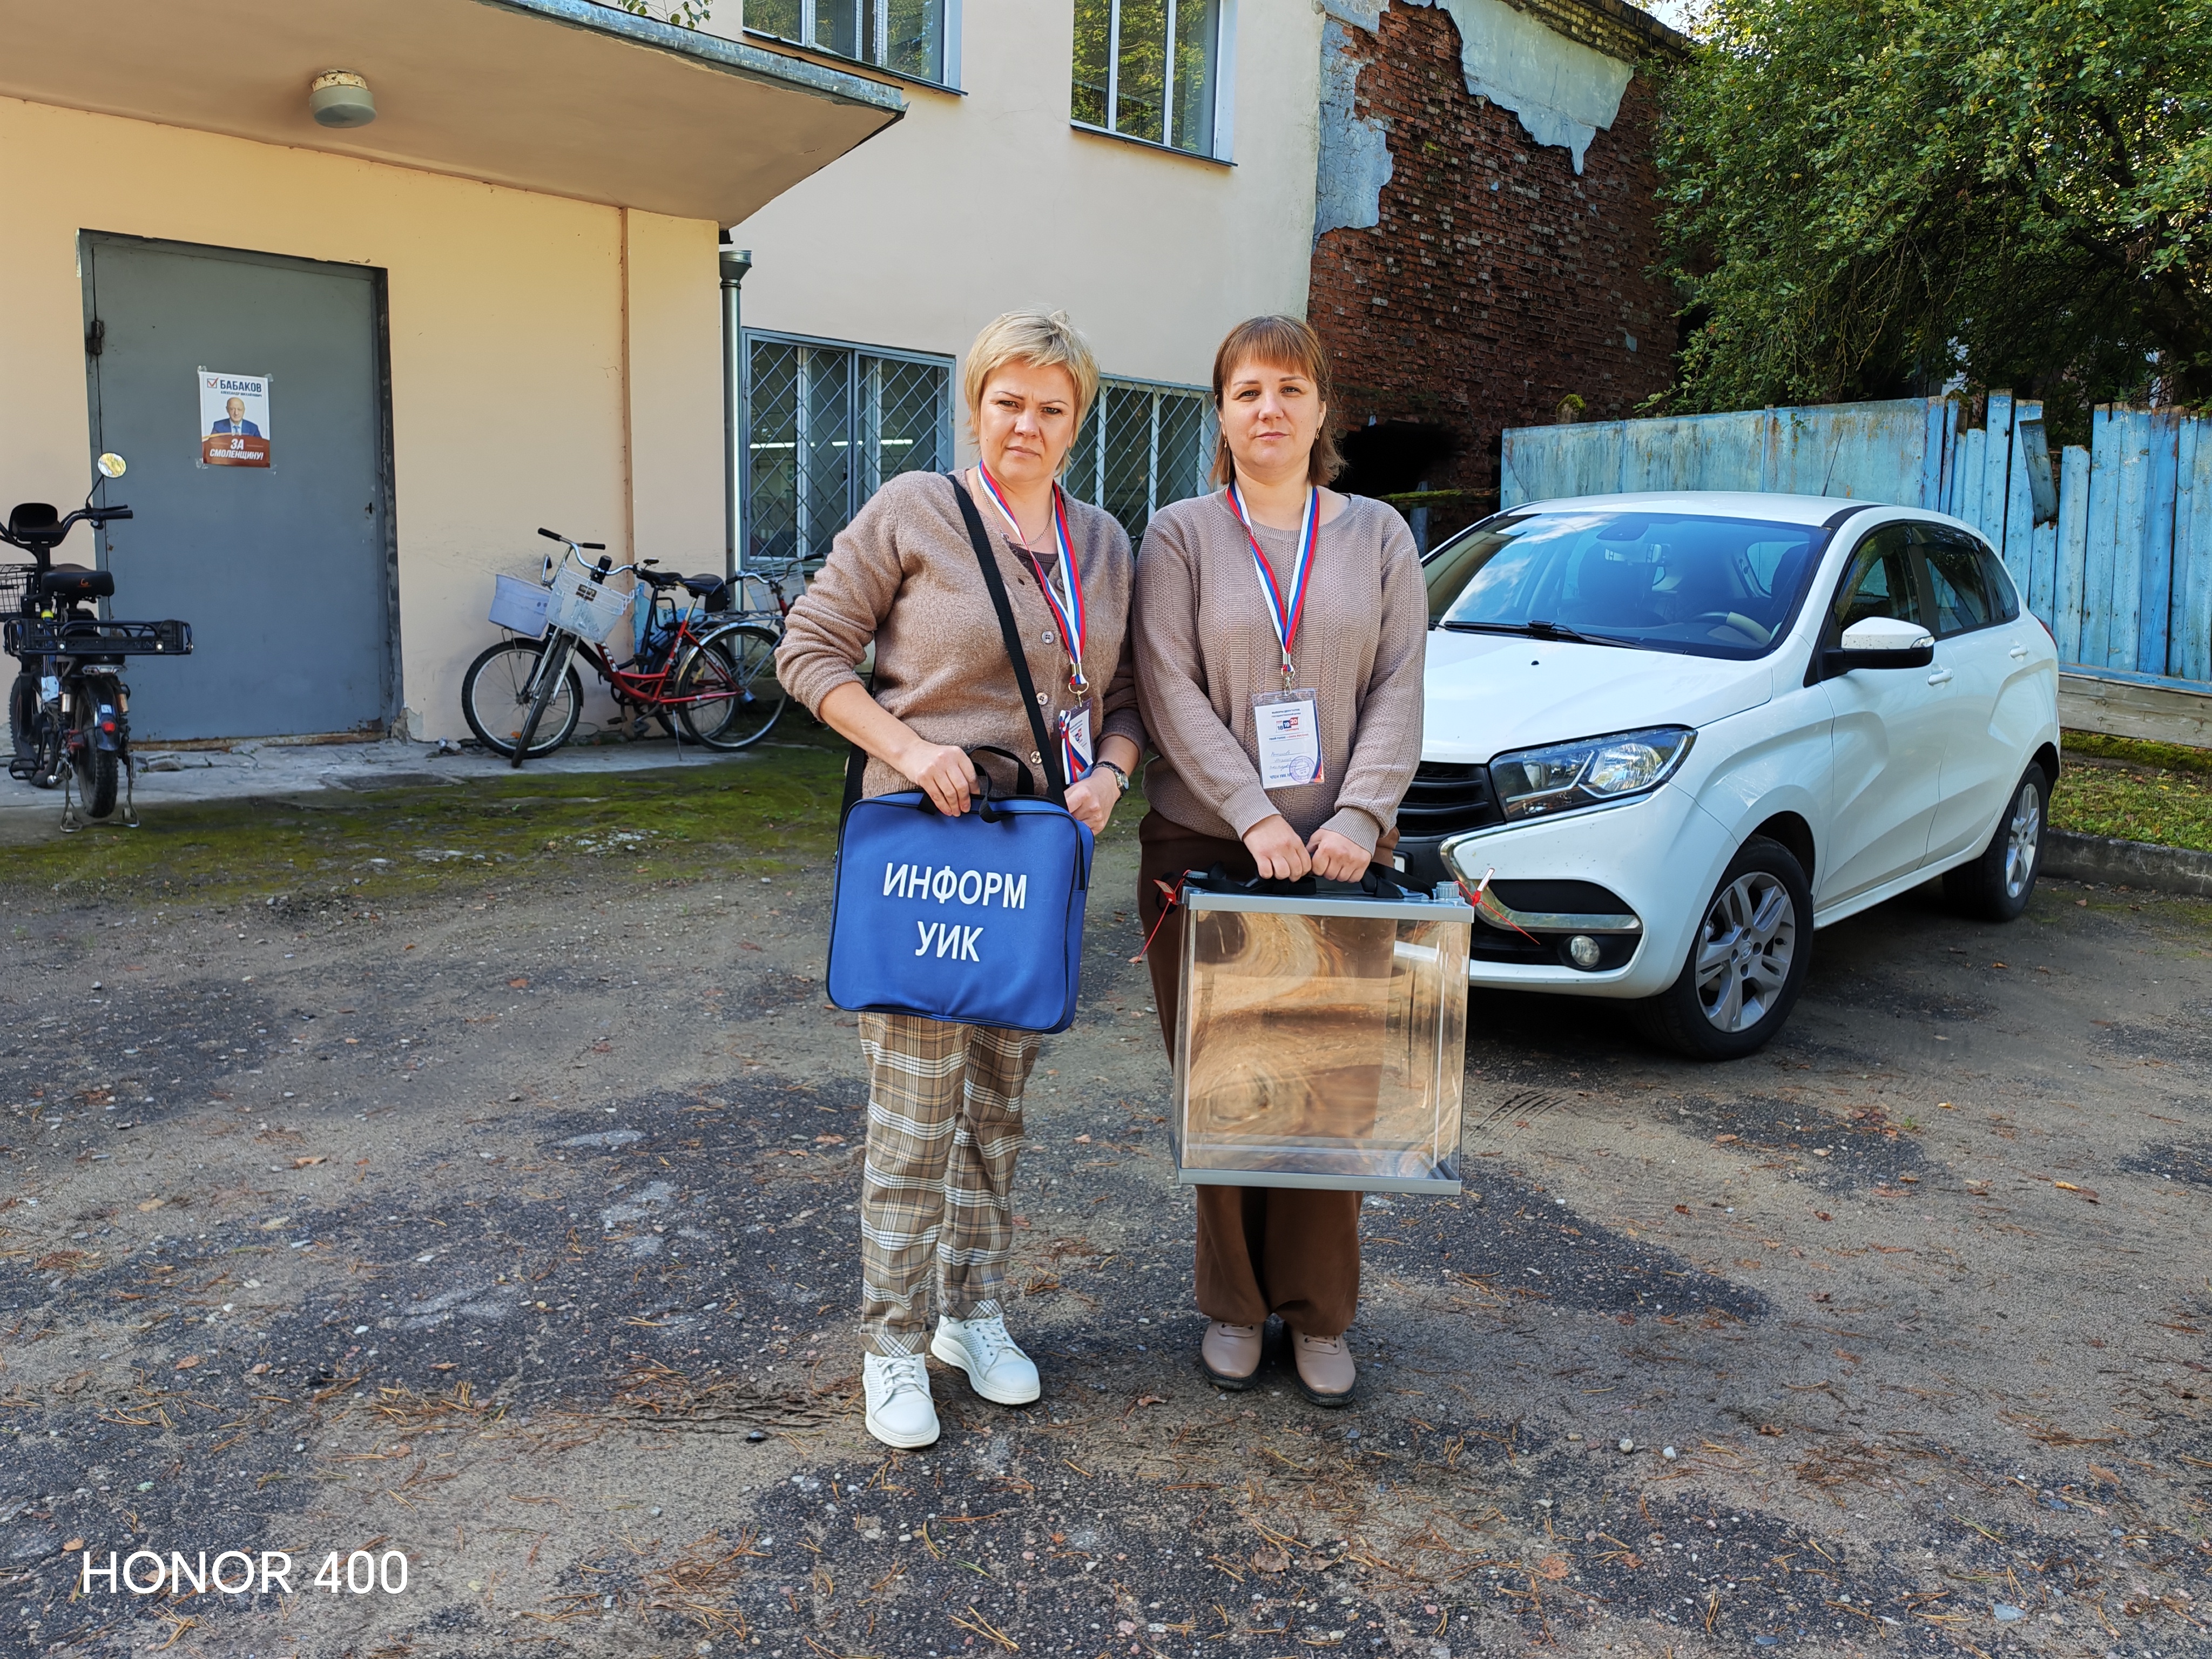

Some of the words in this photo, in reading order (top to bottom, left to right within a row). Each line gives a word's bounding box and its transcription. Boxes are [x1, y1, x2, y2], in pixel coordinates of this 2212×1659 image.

[220, 380, 262, 393] БАБАКОВ
[231, 438, 244, 450] ЗА
[210, 448, 264, 461] СМОЛЕНЩИНУ!
[883, 862, 1027, 909] ИНФОРМ
[915, 921, 984, 962] УИК
